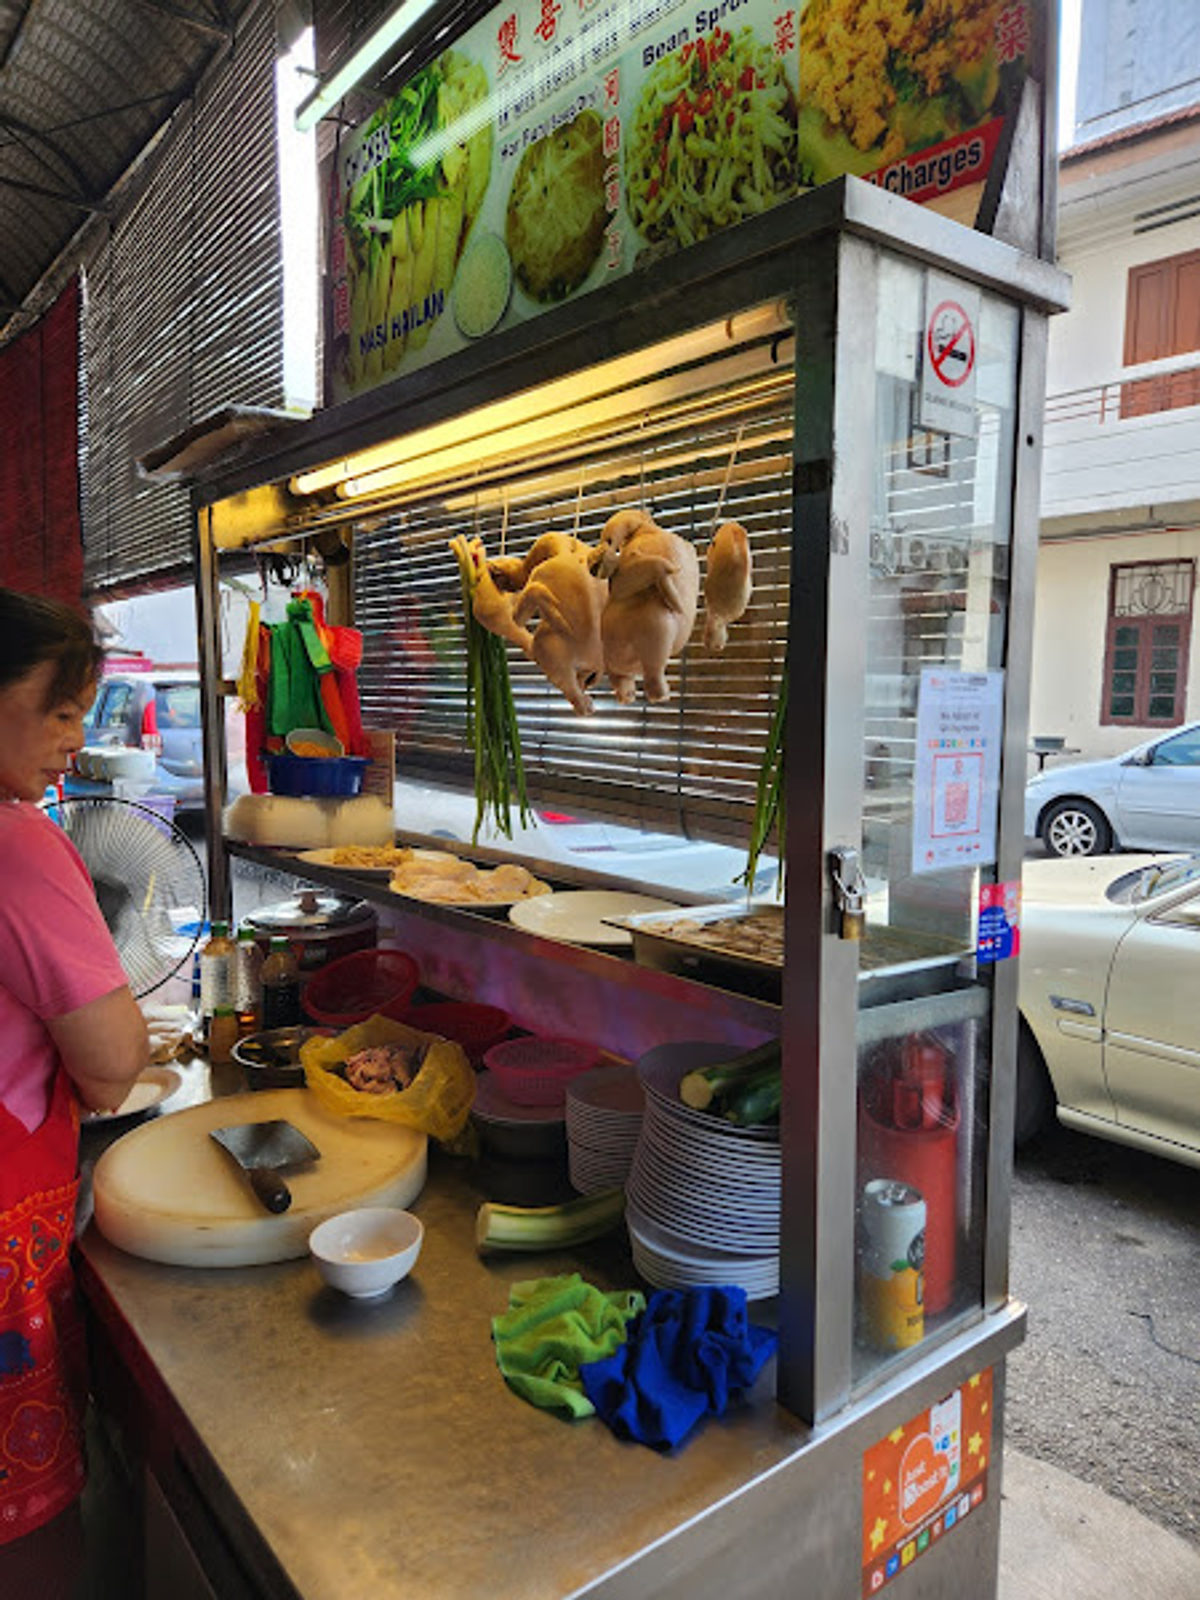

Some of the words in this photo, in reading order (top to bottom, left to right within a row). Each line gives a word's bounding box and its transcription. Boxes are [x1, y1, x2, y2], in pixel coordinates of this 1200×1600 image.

[643, 27, 689, 68] Bean
[996, 4, 1026, 64] 菜
[883, 140, 981, 194] Charges
[359, 323, 388, 355] NASI
